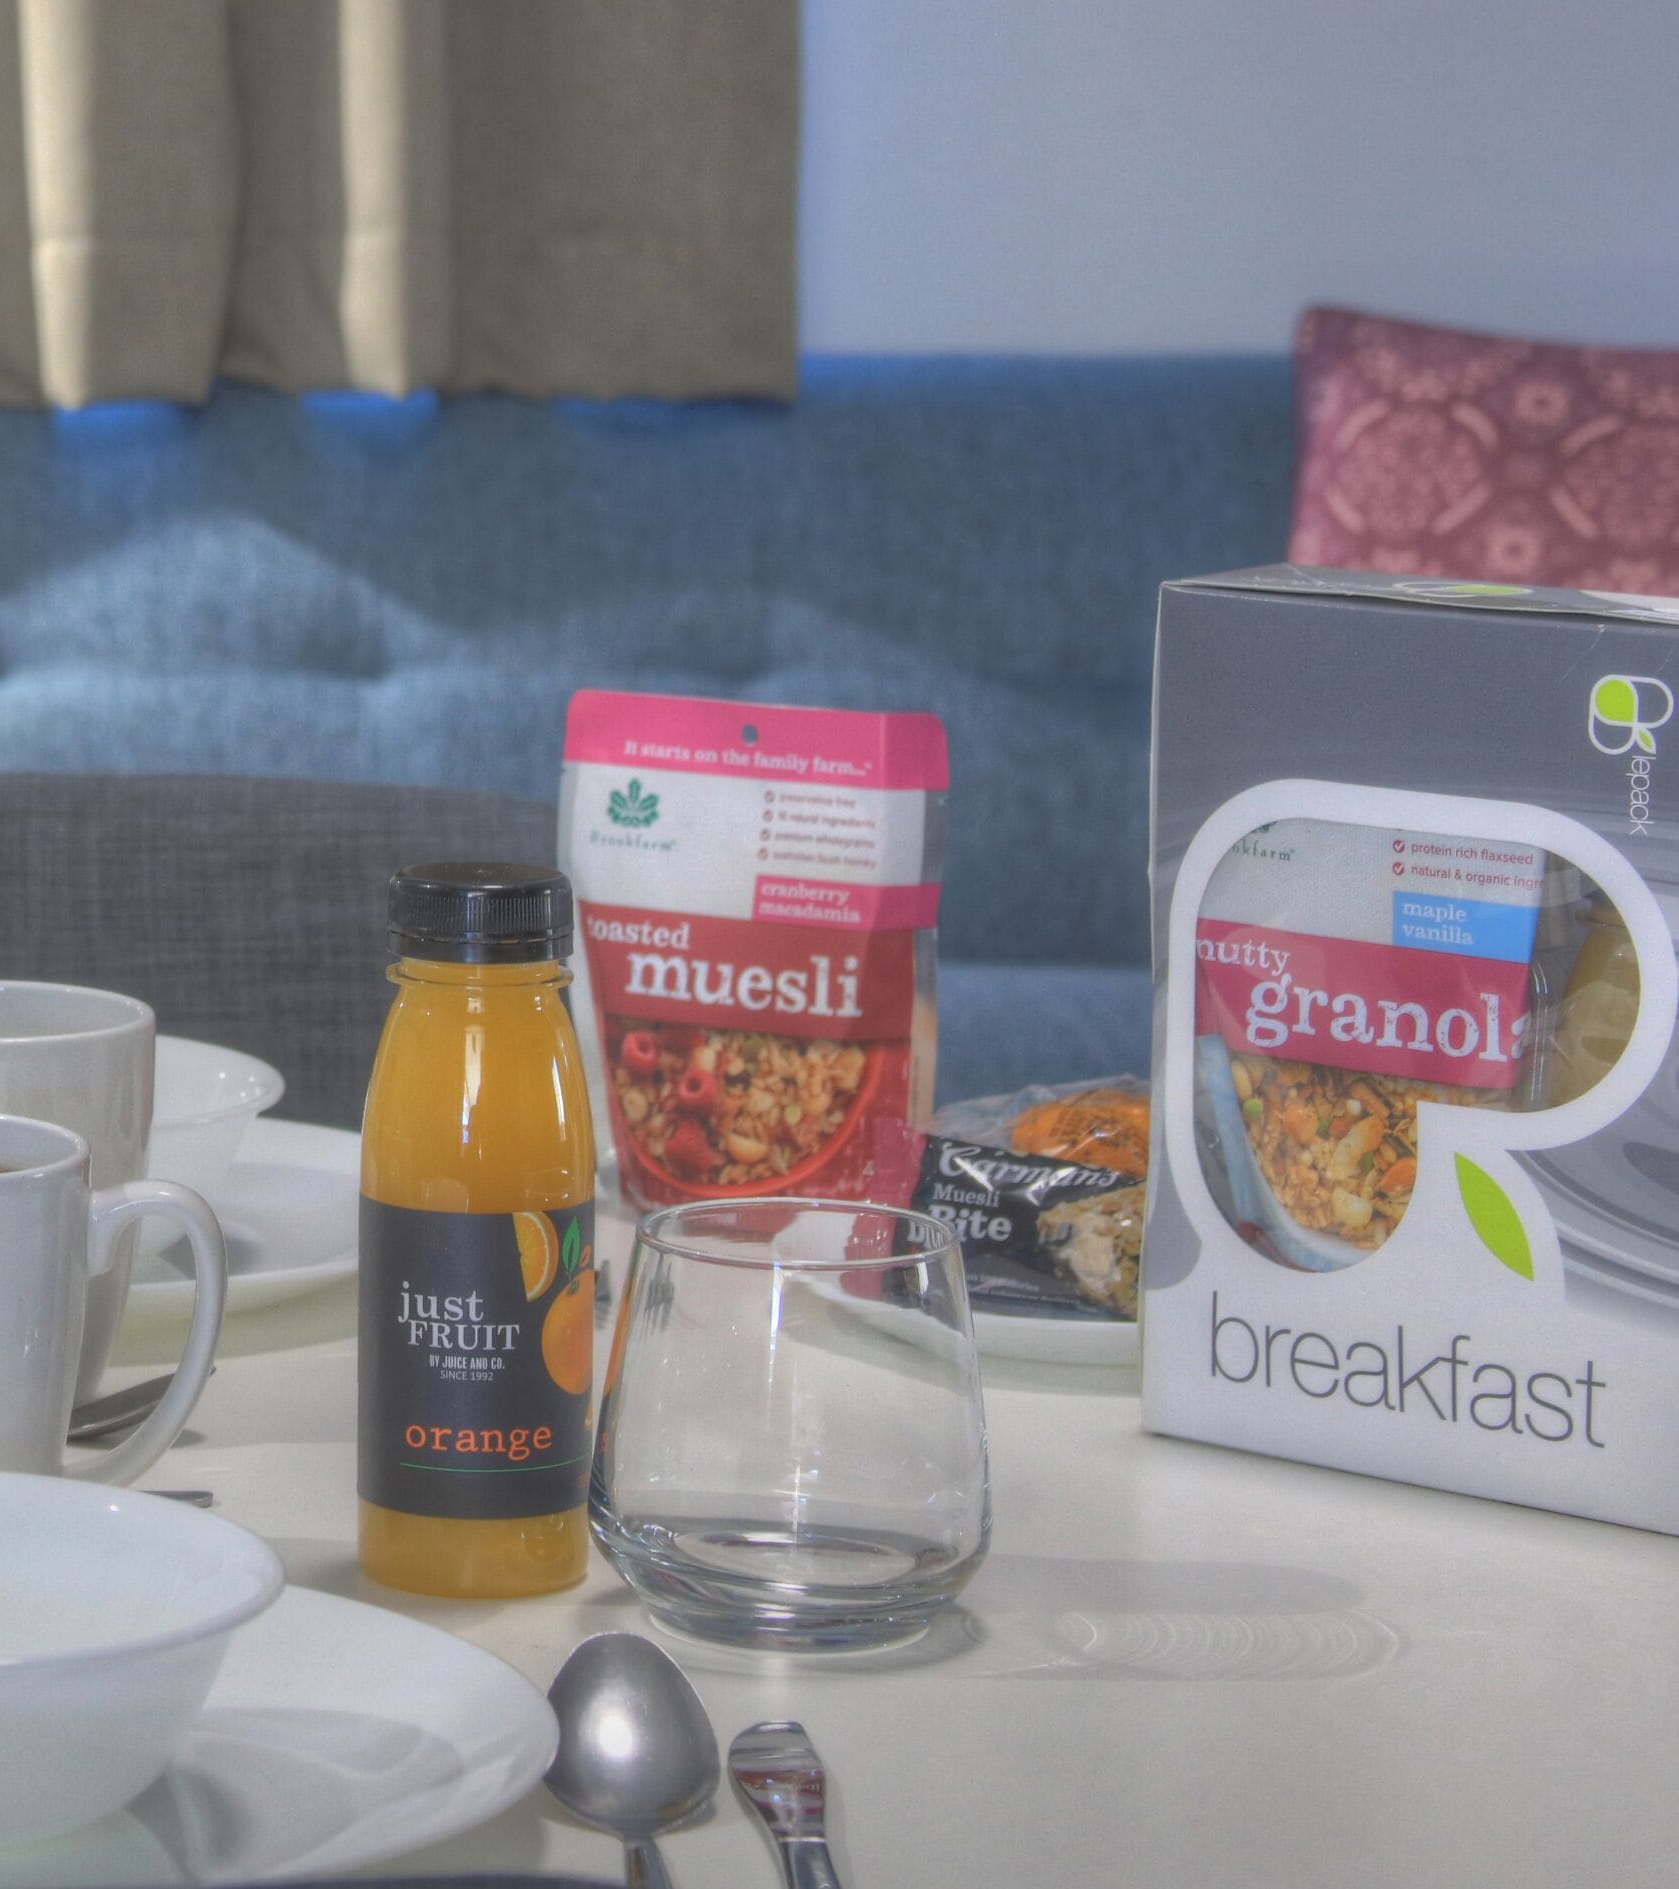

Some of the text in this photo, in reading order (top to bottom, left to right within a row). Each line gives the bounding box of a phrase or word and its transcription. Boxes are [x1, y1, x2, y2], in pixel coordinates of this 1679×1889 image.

[624, 740, 639, 756] It
[640, 743, 690, 762] starts
[694, 748, 718, 764] on
[723, 748, 751, 767] the
[753, 751, 808, 774] family
[1411, 840, 1534, 866] protein rich flaxseed
[1411, 864, 1451, 880] natural
[1453, 869, 1461, 880] &
[1465, 870, 1510, 888] organic
[761, 883, 851, 906] cranberry
[758, 901, 861, 924] macadamia
[1401, 899, 1467, 923] maple
[1401, 920, 1474, 946] vanilla
[1196, 939, 1290, 977] nutty
[624, 952, 863, 1018] muesli
[932, 1183, 1000, 1208] Muesli
[397, 1280, 485, 1323] just
[407, 1319, 520, 1351] FRUIT
[429, 1354, 506, 1370] BY JUICE AND CO.
[1209, 1290, 1607, 1449] breakfast
[440, 1369, 494, 1382] SINCE 1992
[404, 1423, 553, 1461] orange
